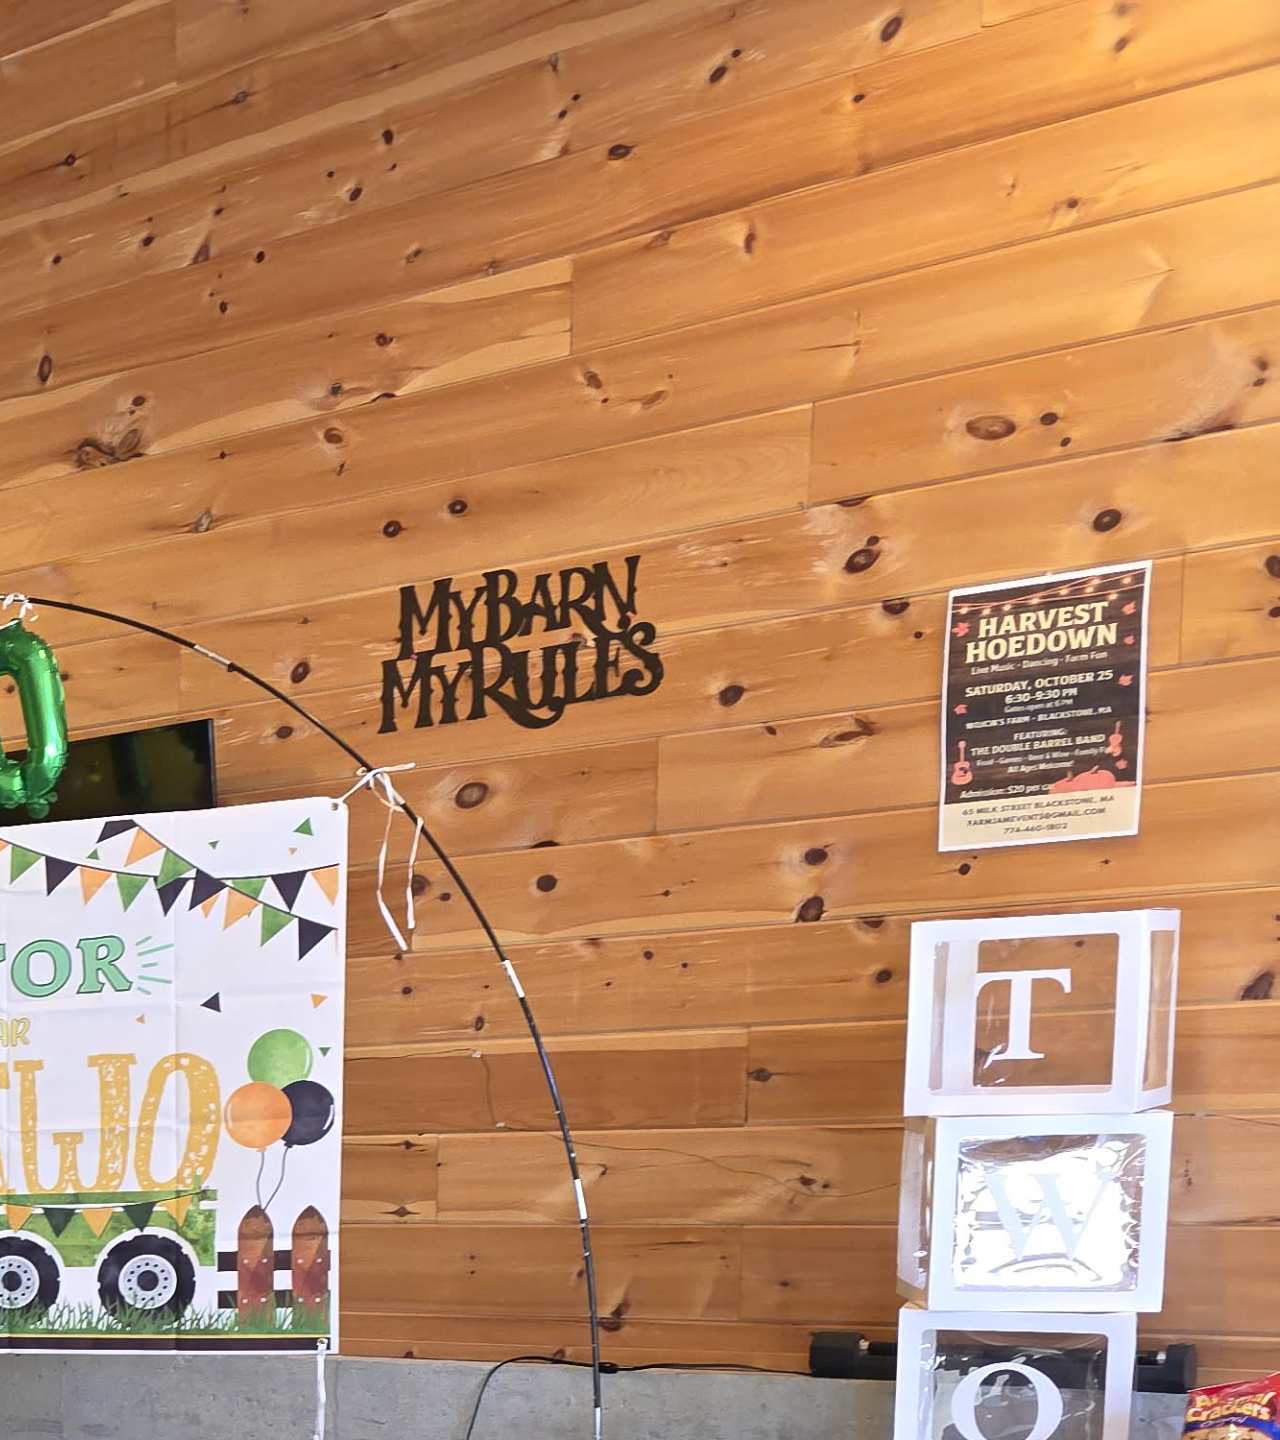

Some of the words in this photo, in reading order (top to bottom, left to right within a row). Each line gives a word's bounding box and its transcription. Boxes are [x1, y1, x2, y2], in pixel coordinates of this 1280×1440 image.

[977, 601, 1109, 639] HARVEST
[965, 623, 1119, 665] HOEDOWN
[965, 680, 1032, 698] SATURDAY,
[1035, 671, 1095, 689] OCTOBER
[1096, 669, 1114, 681] 25
[1061, 686, 1079, 698] PM
[975, 967, 1072, 1062] T
